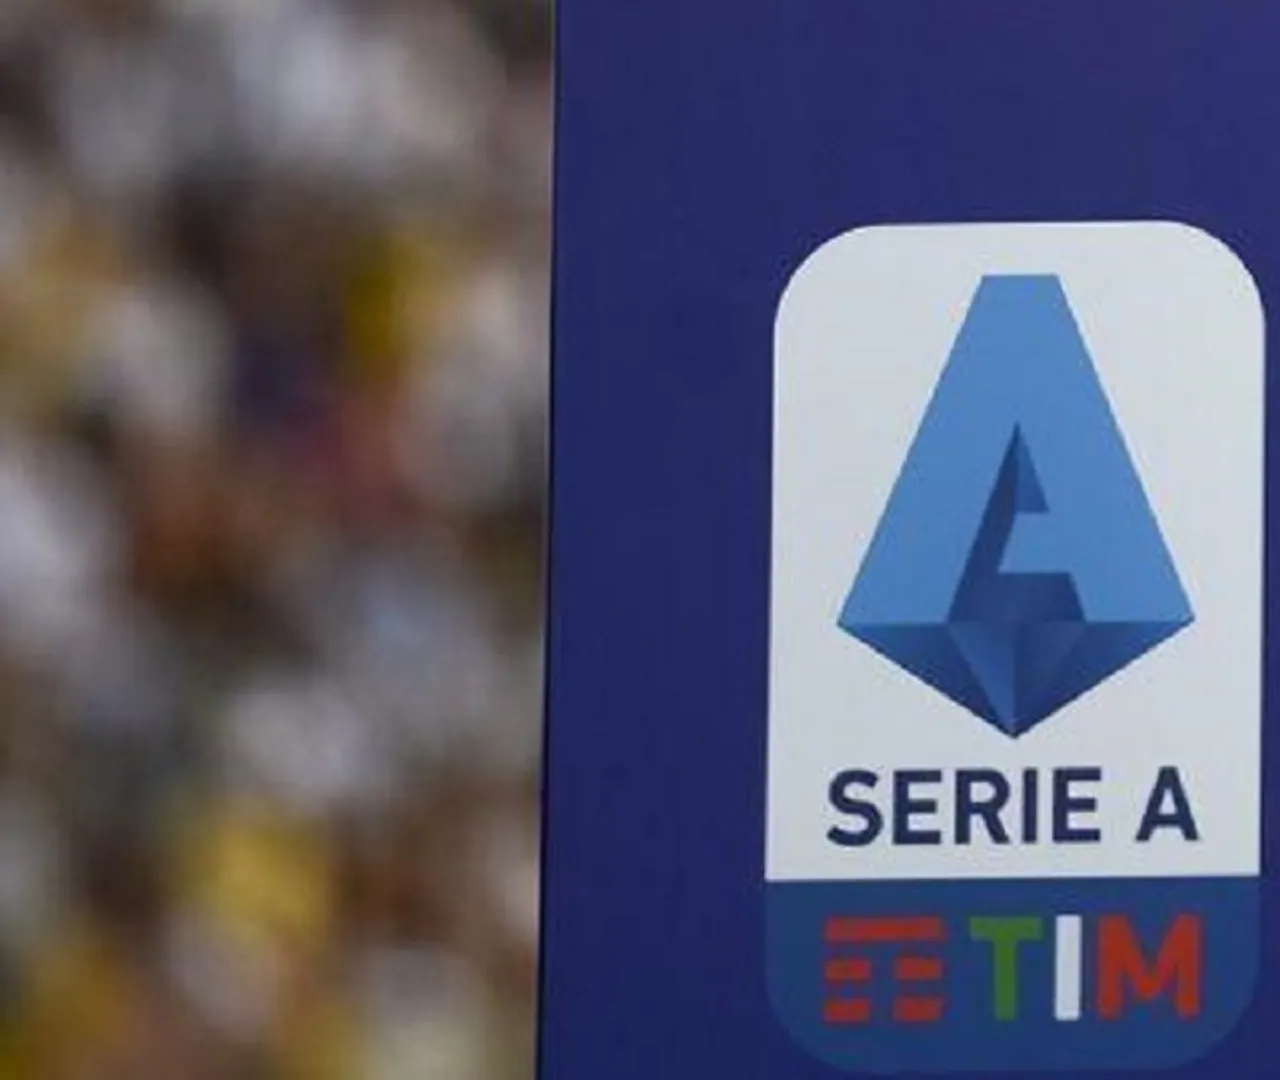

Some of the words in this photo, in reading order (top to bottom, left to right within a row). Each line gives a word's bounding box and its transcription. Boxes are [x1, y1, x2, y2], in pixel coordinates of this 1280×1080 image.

[826, 767, 1103, 847] SERIE
[1135, 766, 1199, 843] A
[969, 914, 1203, 1022] TIM
